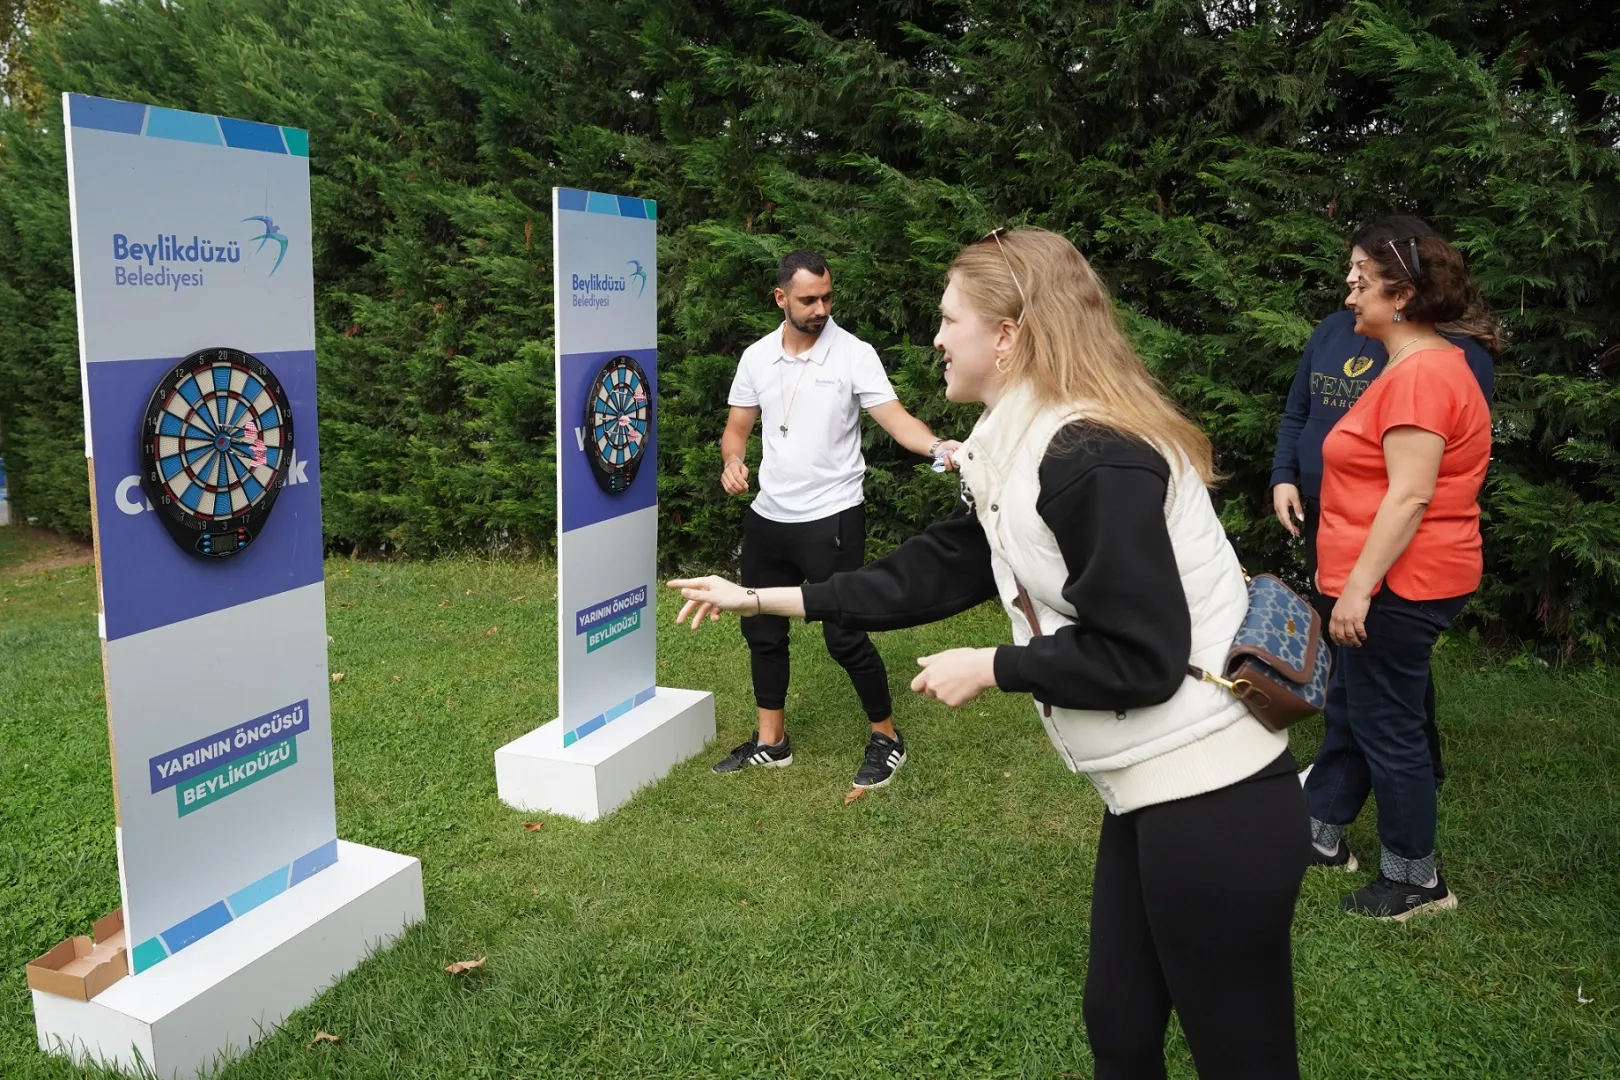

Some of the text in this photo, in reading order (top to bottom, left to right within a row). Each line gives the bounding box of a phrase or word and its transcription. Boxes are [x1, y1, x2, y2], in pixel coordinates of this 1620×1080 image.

[112, 233, 241, 266] Beylikdüzü
[114, 265, 204, 292] Belediyesi
[572, 273, 626, 294] Beylikdüzü
[572, 293, 610, 310] Belediyesi
[199, 355, 205, 365] 5
[218, 350, 229, 360] 20
[242, 355, 247, 364] 1
[174, 369, 185, 378] 12
[258, 366, 268, 376] 18
[160, 390, 166, 400] 9
[275, 385, 281, 395] 4
[283, 409, 292, 418] 13
[147, 417, 157, 426] 14
[287, 432, 293, 441] 6
[144, 444, 155, 454] 11
[151, 471, 157, 481] 8
[160, 495, 171, 505] 16
[241, 514, 251, 524] 17
[222, 521, 228, 531] 3
[579, 589, 645, 627] YARININ ÖNCÜSÜ
[589, 612, 638, 647] BEYLİKDÜZÜ
[156, 705, 304, 779] YARININ ÖNCÜSÜ
[183, 741, 290, 806] BEYLİKDÜZÜ
